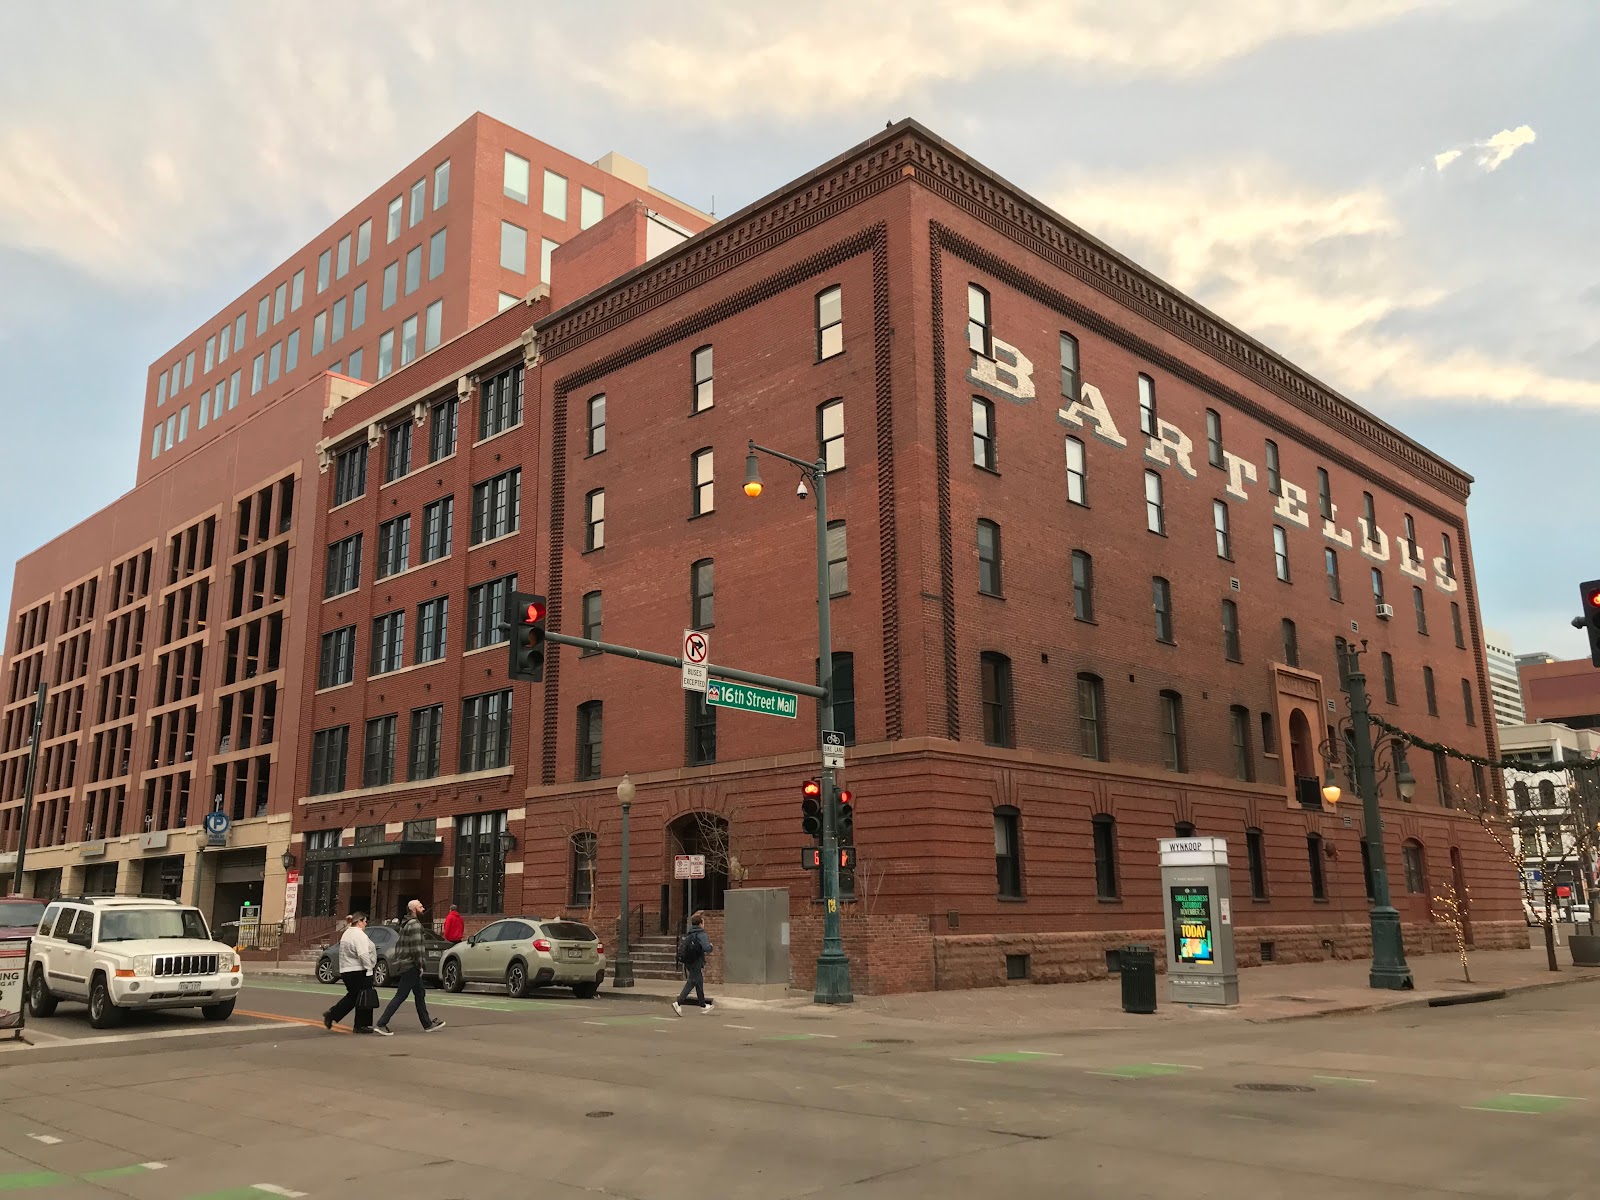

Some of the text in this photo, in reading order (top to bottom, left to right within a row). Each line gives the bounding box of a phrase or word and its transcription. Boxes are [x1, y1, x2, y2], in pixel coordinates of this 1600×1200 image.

[966, 336, 1458, 592] BARTELDES
[687, 668, 702, 677] BUSES
[683, 677, 705, 688] EXCEPTED
[721, 686, 795, 713] 16th Street Mall
[834, 746, 844, 754] LANE
[1169, 841, 1202, 852] WYNKOOP
[1180, 924, 1206, 938] TODAY
